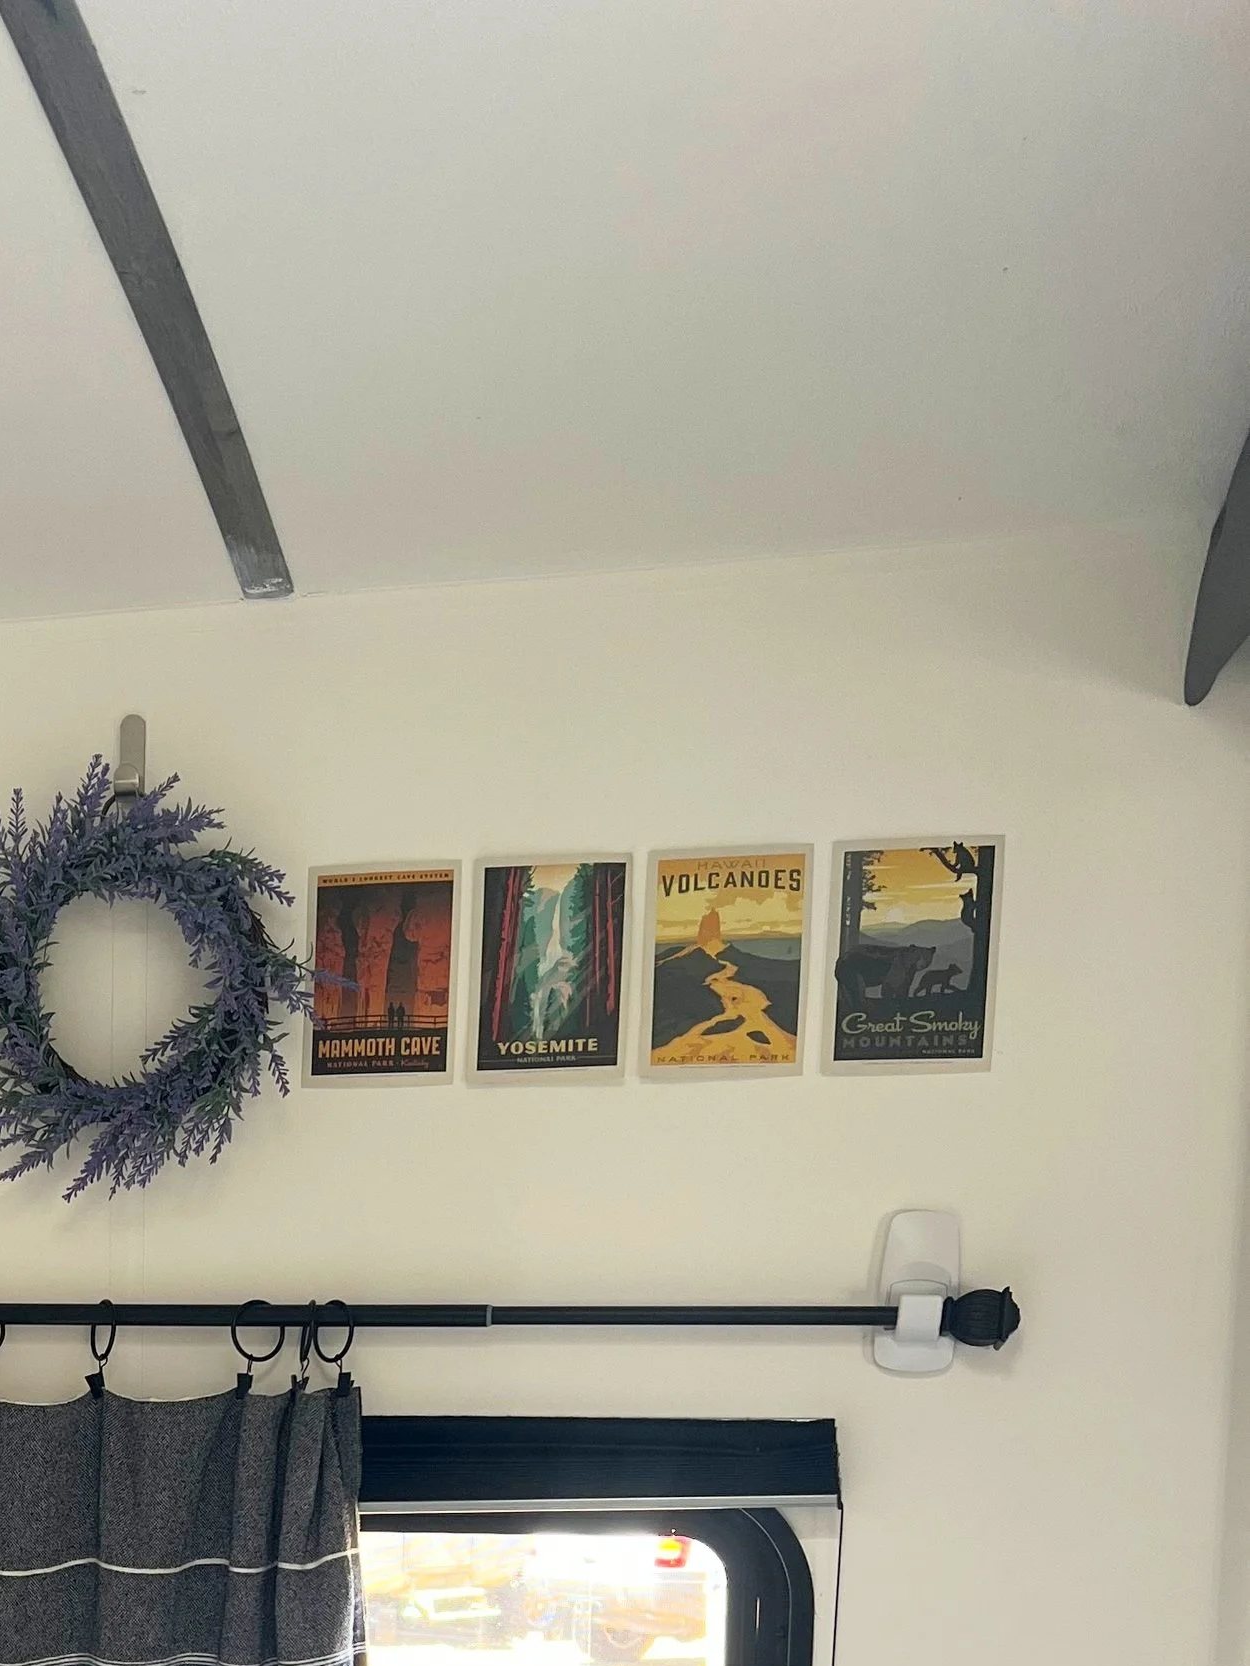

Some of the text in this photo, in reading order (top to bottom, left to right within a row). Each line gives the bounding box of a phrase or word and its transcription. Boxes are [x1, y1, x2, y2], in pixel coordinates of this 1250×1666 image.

[662, 868, 802, 898] VOLCANOES
[841, 1010, 981, 1040] Great Smoky
[318, 1036, 441, 1059] MAMMOTH CAVE
[497, 1038, 599, 1056] YOSEMITE
[842, 1034, 968, 1049] MOUNTAINS
[326, 1060, 369, 1069] NATIONAL
[372, 1059, 395, 1067] PARK
[657, 1053, 791, 1064] NATIONAL PARK
